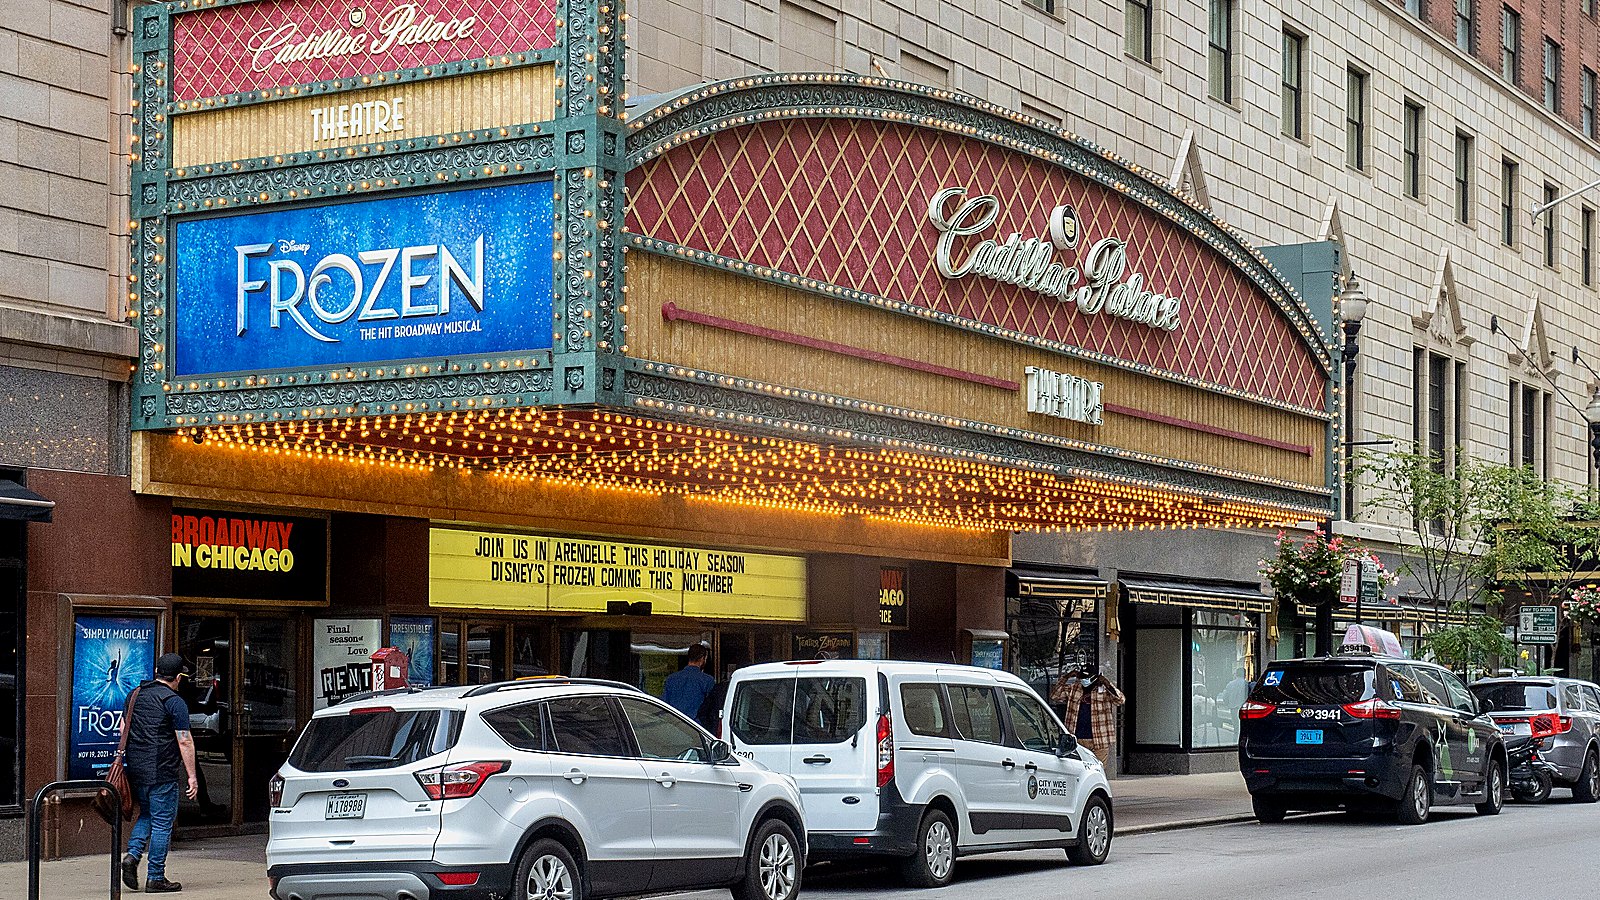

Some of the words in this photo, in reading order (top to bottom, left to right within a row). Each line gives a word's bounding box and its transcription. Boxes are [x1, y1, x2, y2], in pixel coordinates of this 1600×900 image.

[248, 22, 367, 73] Cadillac
[371, 2, 476, 55] Palace
[310, 97, 405, 142] THEATRE
[928, 187, 1081, 303] Cadillac
[1076, 236, 1181, 332] Palace
[233, 233, 484, 343] FROZEN
[360, 328, 377, 341] THE
[377, 326, 393, 339] HIT
[394, 322, 443, 338] BROADWAY
[443, 320, 483, 334] MUSICAL
[1024, 366, 1104, 425] THEATRE
[171, 514, 294, 552] BROADWAY
[195, 543, 294, 573] CHICAGO
[475, 536, 504, 558] JOIN
[512, 538, 529, 560] US
[534, 540, 547, 561] IN
[554, 541, 617, 565] ARENDELLE
[623, 546, 649, 567] THIS
[653, 548, 700, 571] HOLIDAY
[707, 553, 745, 574] SEASON
[491, 561, 545, 584] DISNEY'S
[553, 564, 596, 587] FROZEN
[601, 567, 641, 588] COMING
[649, 570, 673, 590] THIS
[683, 572, 734, 594] NOVEMBER
[326, 624, 350, 635] Final
[329, 635, 359, 644] season
[347, 646, 369, 656] Love
[322, 667, 372, 692] RENT
[78, 706, 123, 737] FROZ
[1314, 709, 1341, 720] 3941
